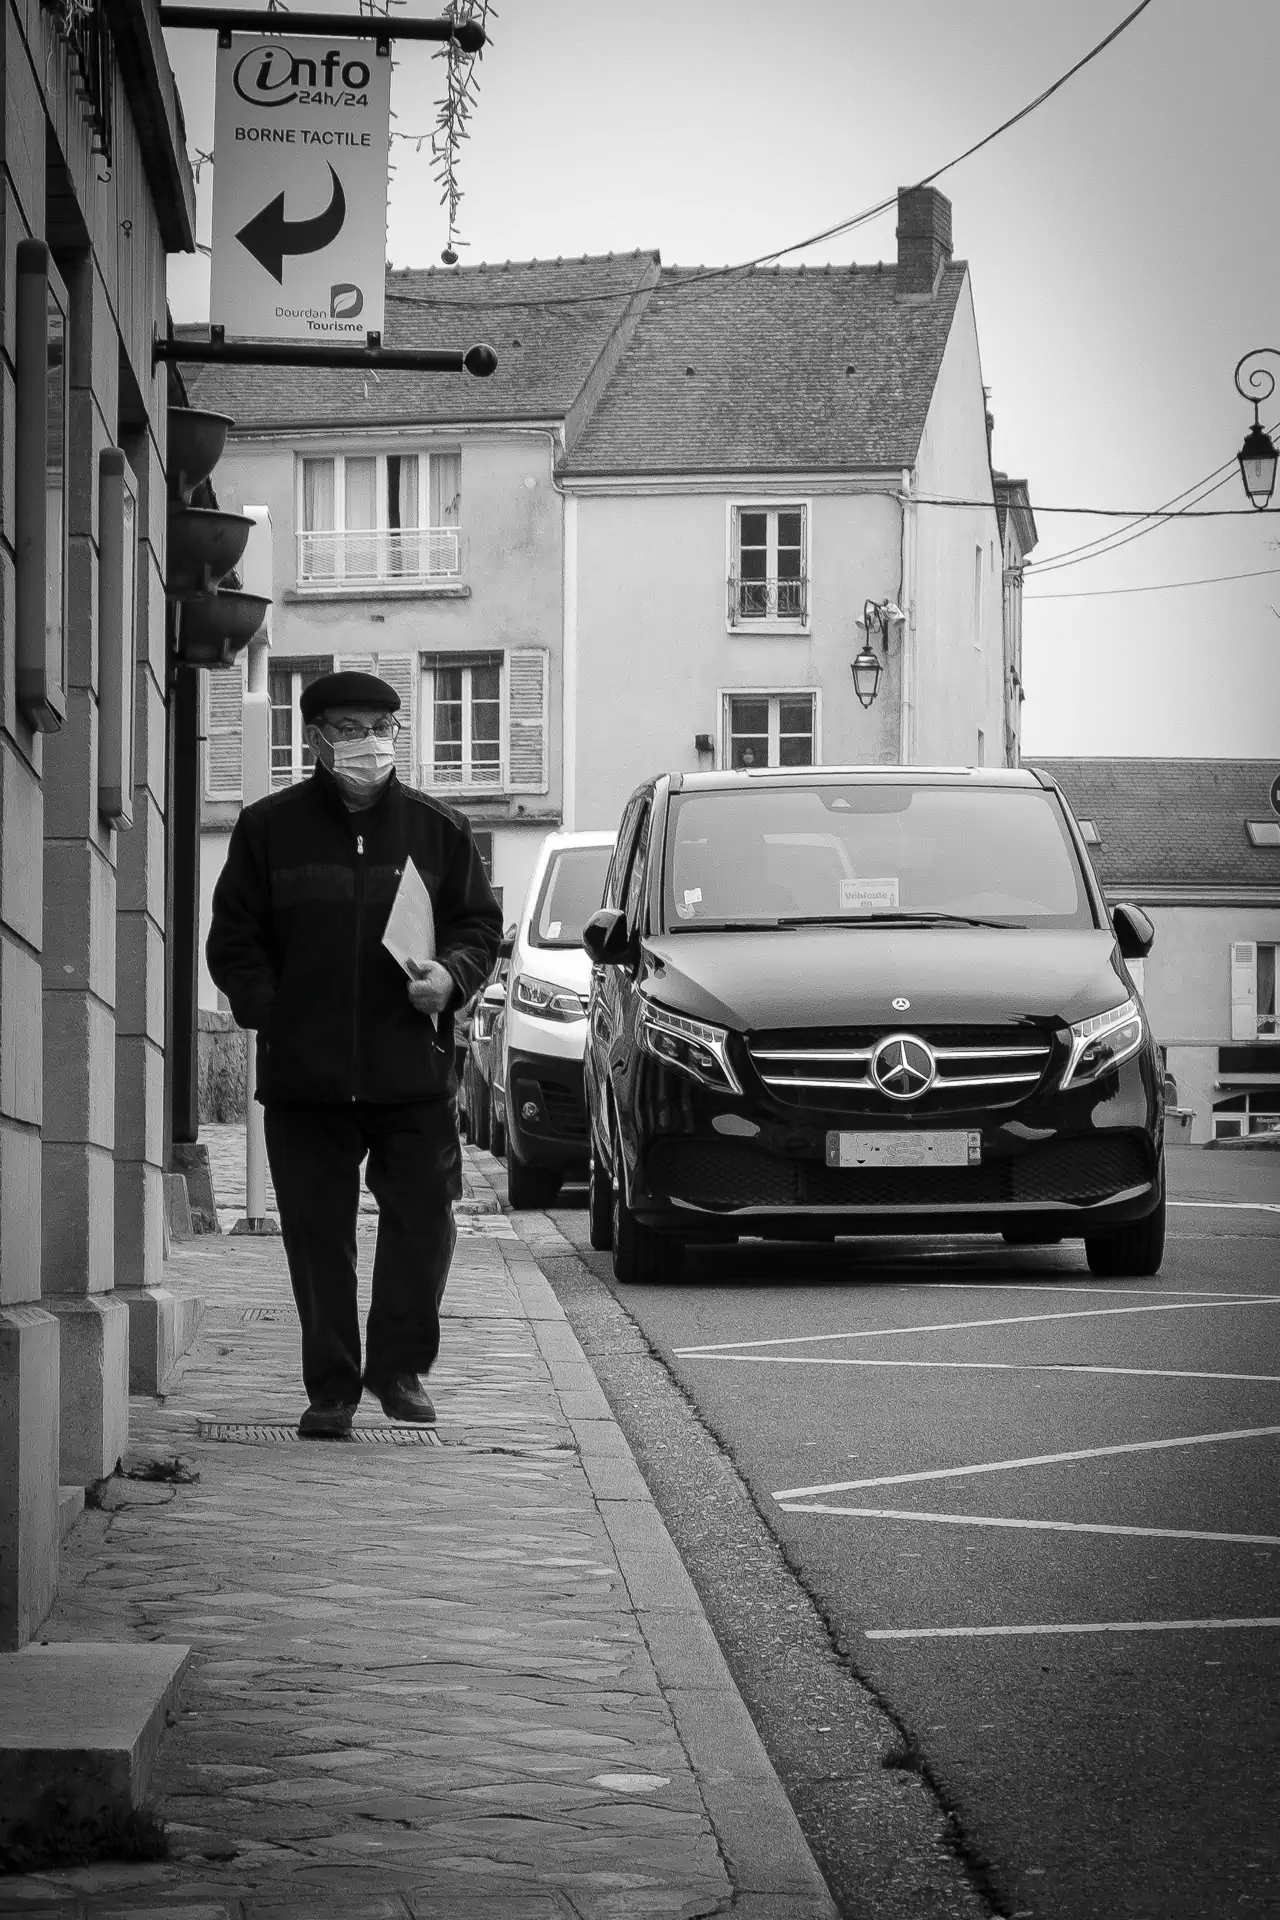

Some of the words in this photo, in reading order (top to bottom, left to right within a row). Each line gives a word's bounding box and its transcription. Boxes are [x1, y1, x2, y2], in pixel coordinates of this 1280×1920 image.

[299, 90, 368, 107] 24h/24
[235, 127, 296, 143] BORNE
[301, 130, 371, 146] TACTILE
[275, 307, 327, 318] Dourdan
[307, 320, 363, 331] Tourisme
